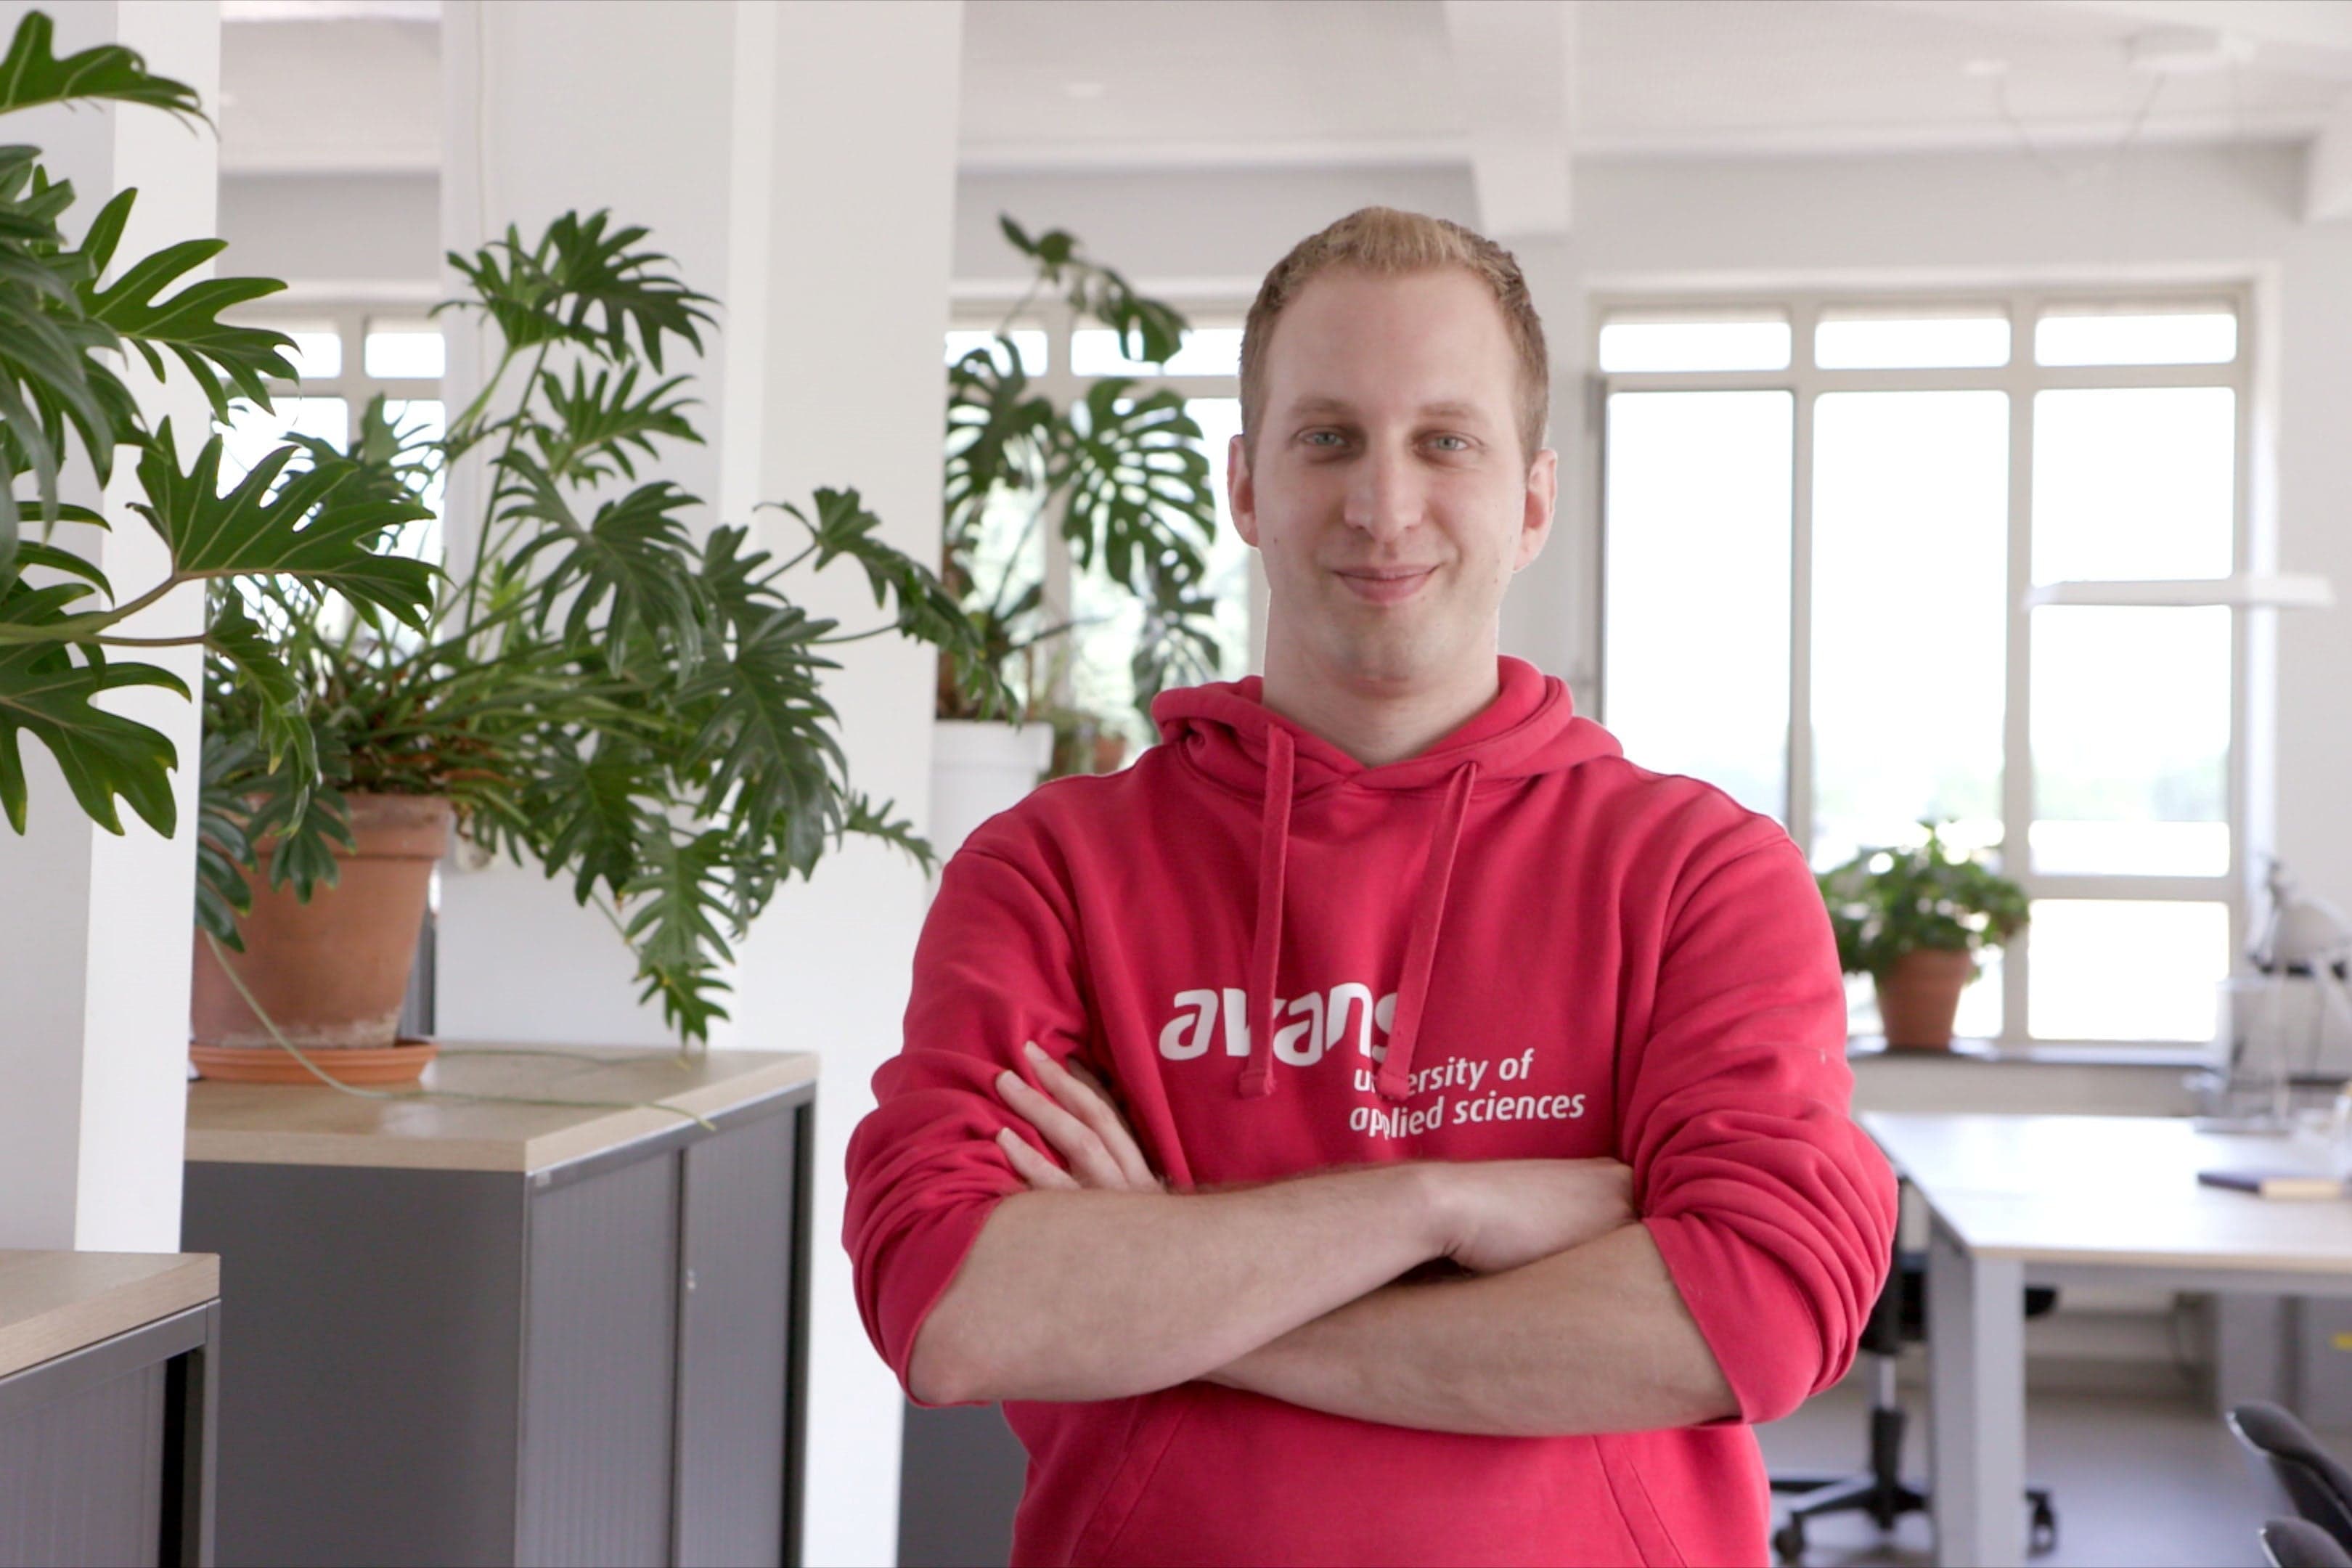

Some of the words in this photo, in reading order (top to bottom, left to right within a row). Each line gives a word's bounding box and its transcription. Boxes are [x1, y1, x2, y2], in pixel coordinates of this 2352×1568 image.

[1353, 1056, 1490, 1096] uersity
[1498, 1047, 1535, 1082] of
[1349, 1095, 1445, 1140] applied
[1453, 1089, 1586, 1125] sciences
